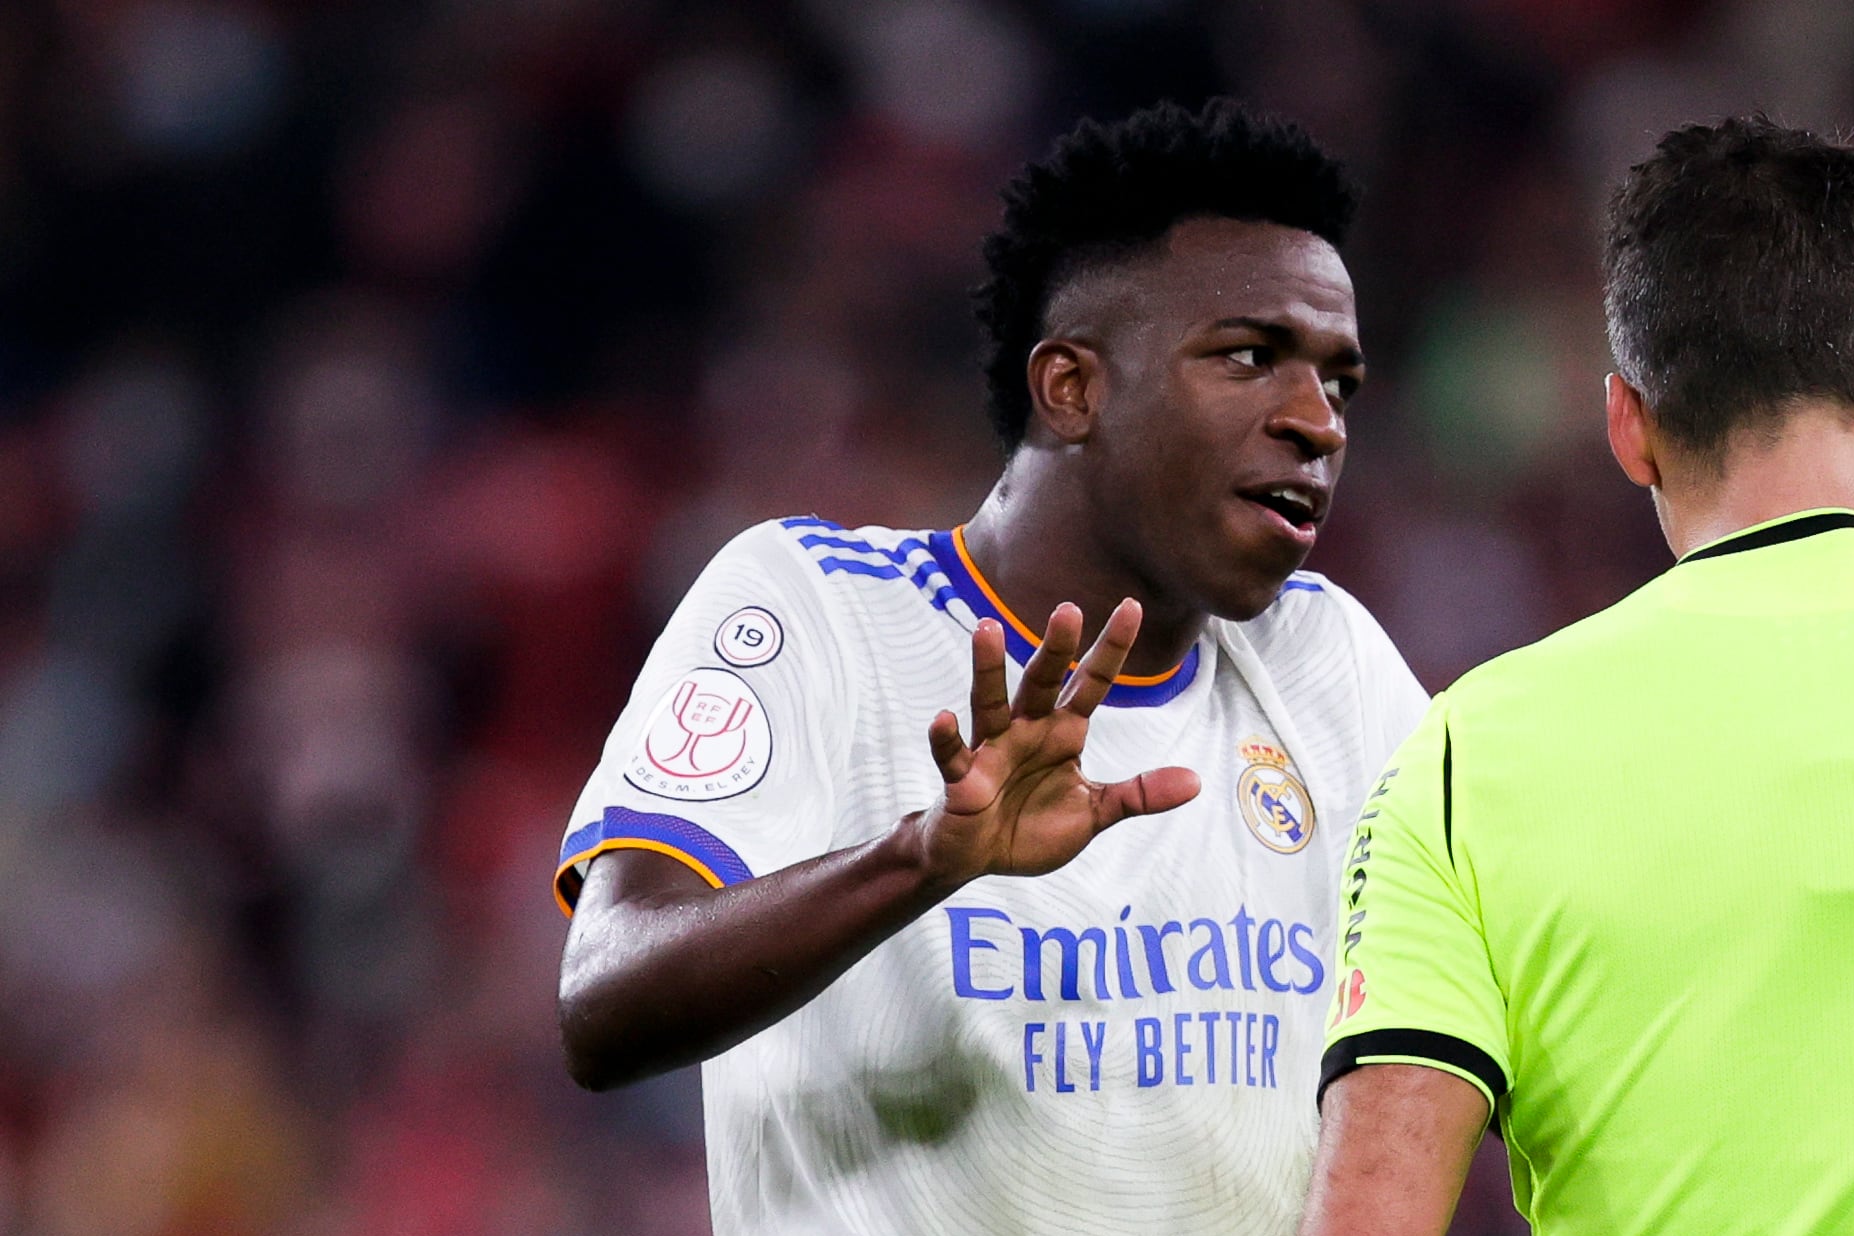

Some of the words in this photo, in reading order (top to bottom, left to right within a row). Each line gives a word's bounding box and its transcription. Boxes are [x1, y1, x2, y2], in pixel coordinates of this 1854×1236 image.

[733, 623, 764, 648] 19
[704, 780, 728, 792] EL
[732, 755, 756, 783] REY
[943, 901, 1325, 1002] Emirates
[1023, 1021, 1107, 1094] FLY
[1134, 1010, 1280, 1089] BETTER
